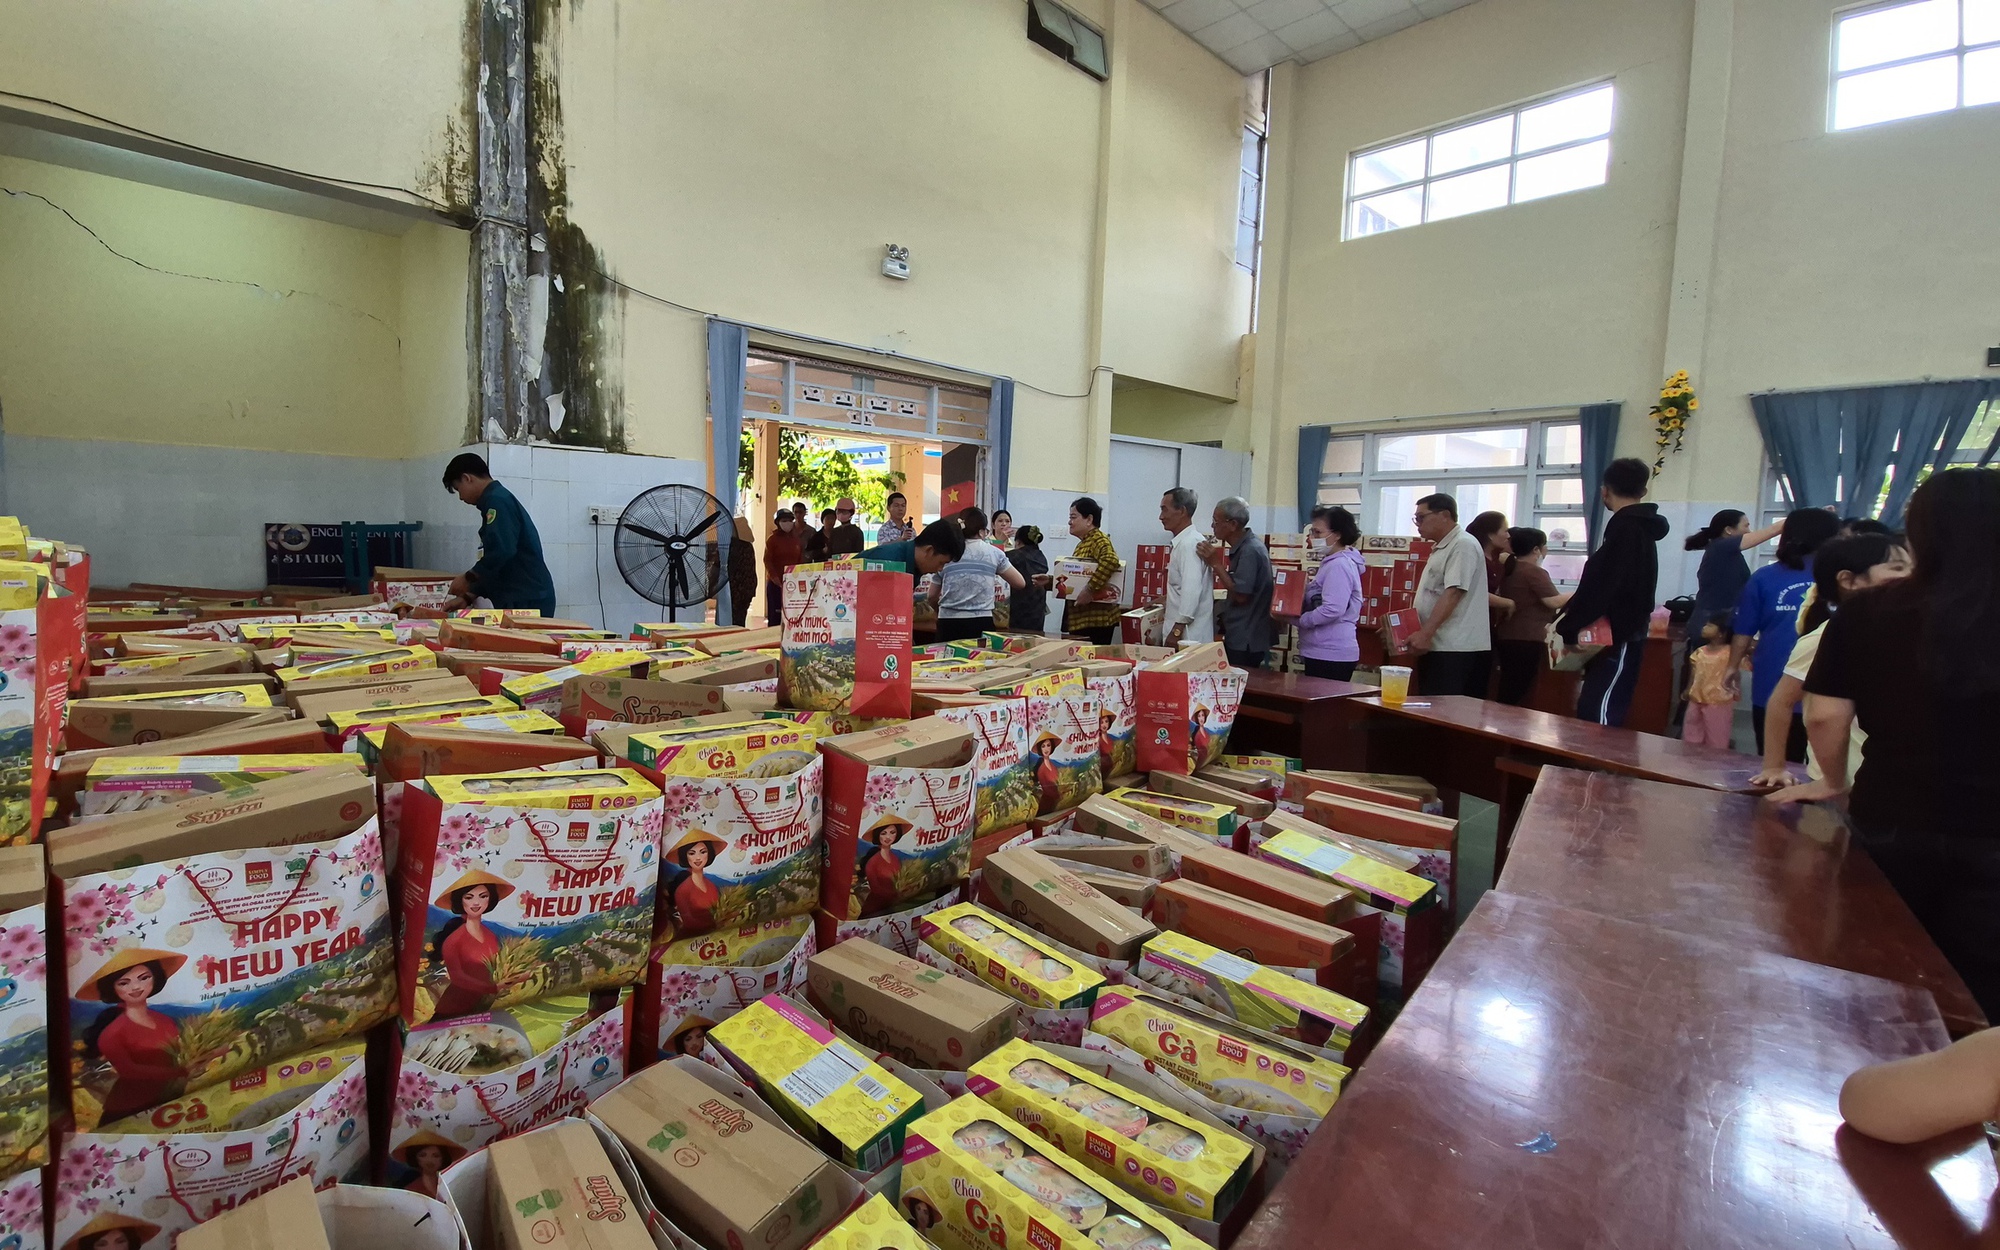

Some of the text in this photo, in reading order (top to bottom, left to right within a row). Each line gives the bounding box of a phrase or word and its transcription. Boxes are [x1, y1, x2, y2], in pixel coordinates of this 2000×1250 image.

[707, 750, 737, 771] Gà
[570, 801, 590, 809] FOOD
[249, 872, 269, 881] FOOD
[553, 864, 624, 889] HAPPY
[526, 887, 635, 918] NEW YEAR
[238, 906, 337, 944] HAPPY
[206, 949, 283, 987] NEW
[291, 926, 361, 967] YEAR
[699, 940, 728, 961] Gà
[1148, 1019, 1174, 1032] Cháo
[1158, 1032, 1197, 1065] Gà
[1221, 1044, 1243, 1058] FOOD
[235, 1076, 262, 1087] FOOD
[152, 1097, 209, 1129] Gà
[1016, 1107, 1042, 1123] Cháo
[1088, 1135, 1111, 1151] SIMPLY
[1088, 1143, 1112, 1160] FOOD
[954, 1178, 981, 1199] Cháo
[965, 1198, 1007, 1249] Gà
[1031, 1223, 1055, 1245] SIMPLY
[1031, 1231, 1056, 1250] FOOD
